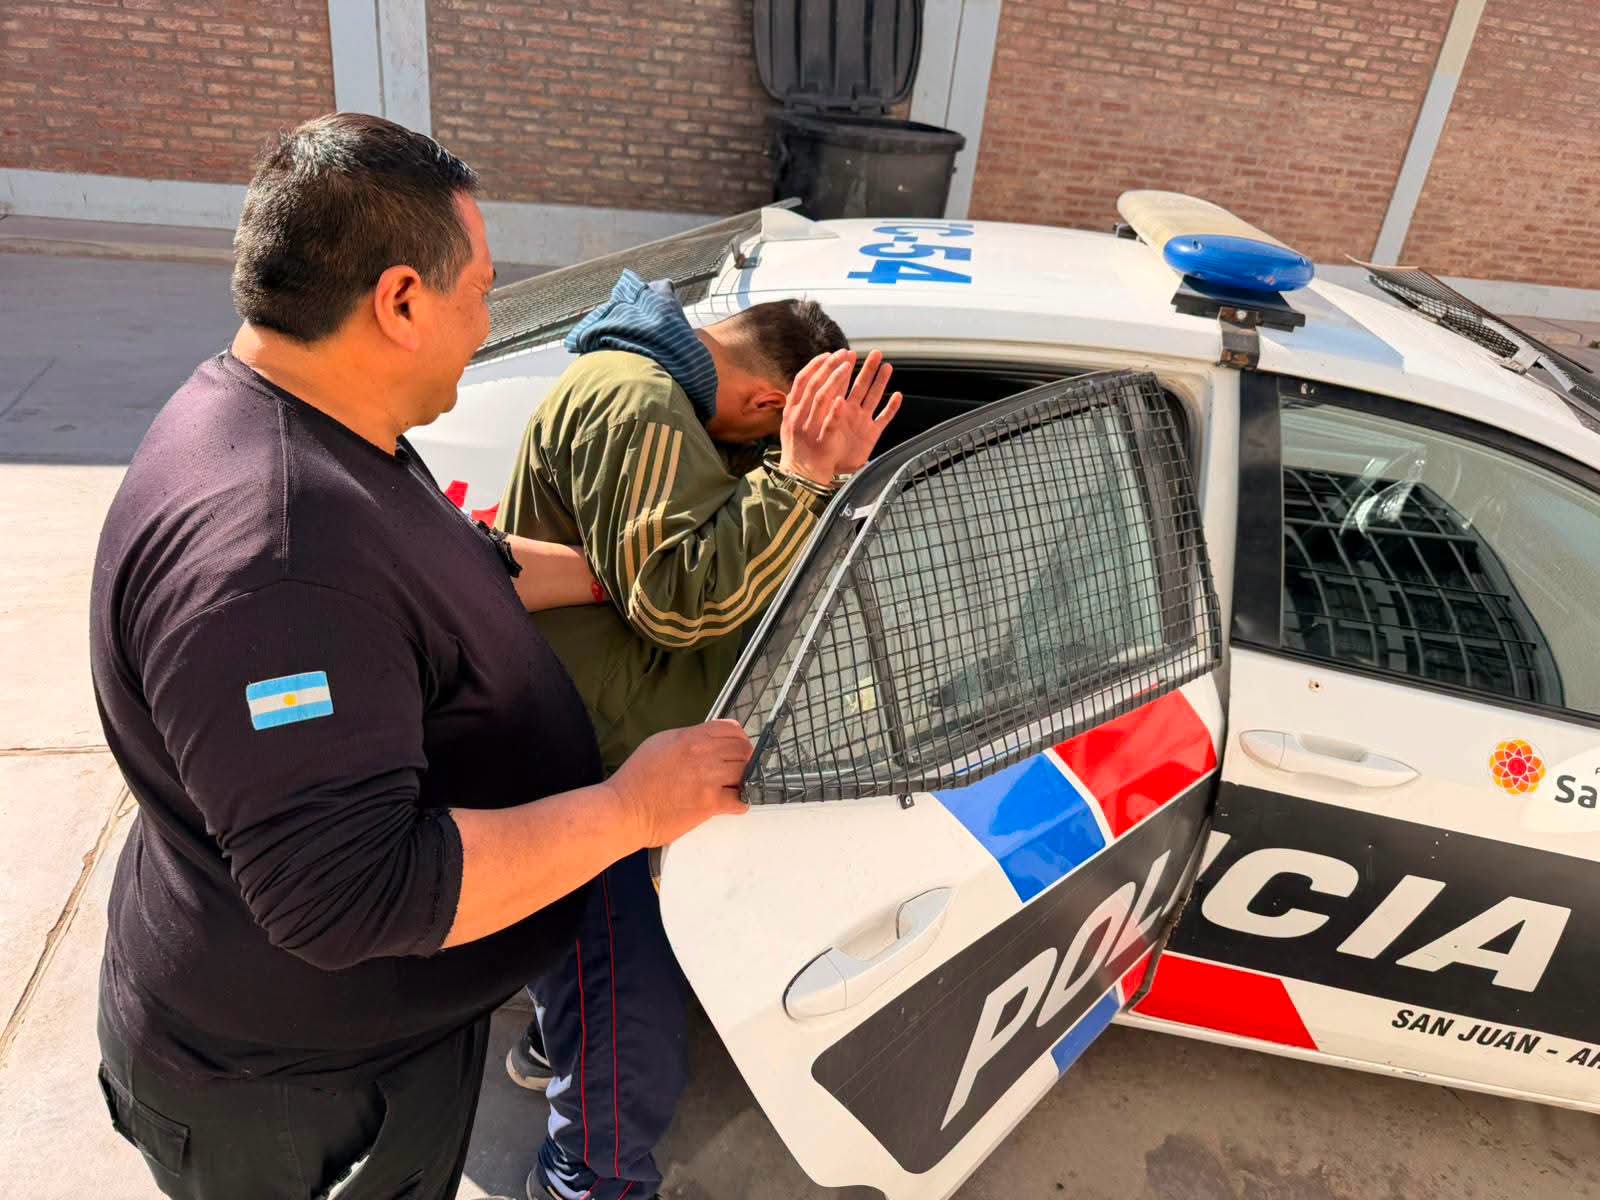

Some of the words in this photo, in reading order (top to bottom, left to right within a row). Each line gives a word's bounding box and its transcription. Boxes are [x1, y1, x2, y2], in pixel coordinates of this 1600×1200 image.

[1196, 830, 1571, 992] CIA
[1391, 1009, 1454, 1037] SAN
[1457, 1024, 1540, 1055] JUAN
